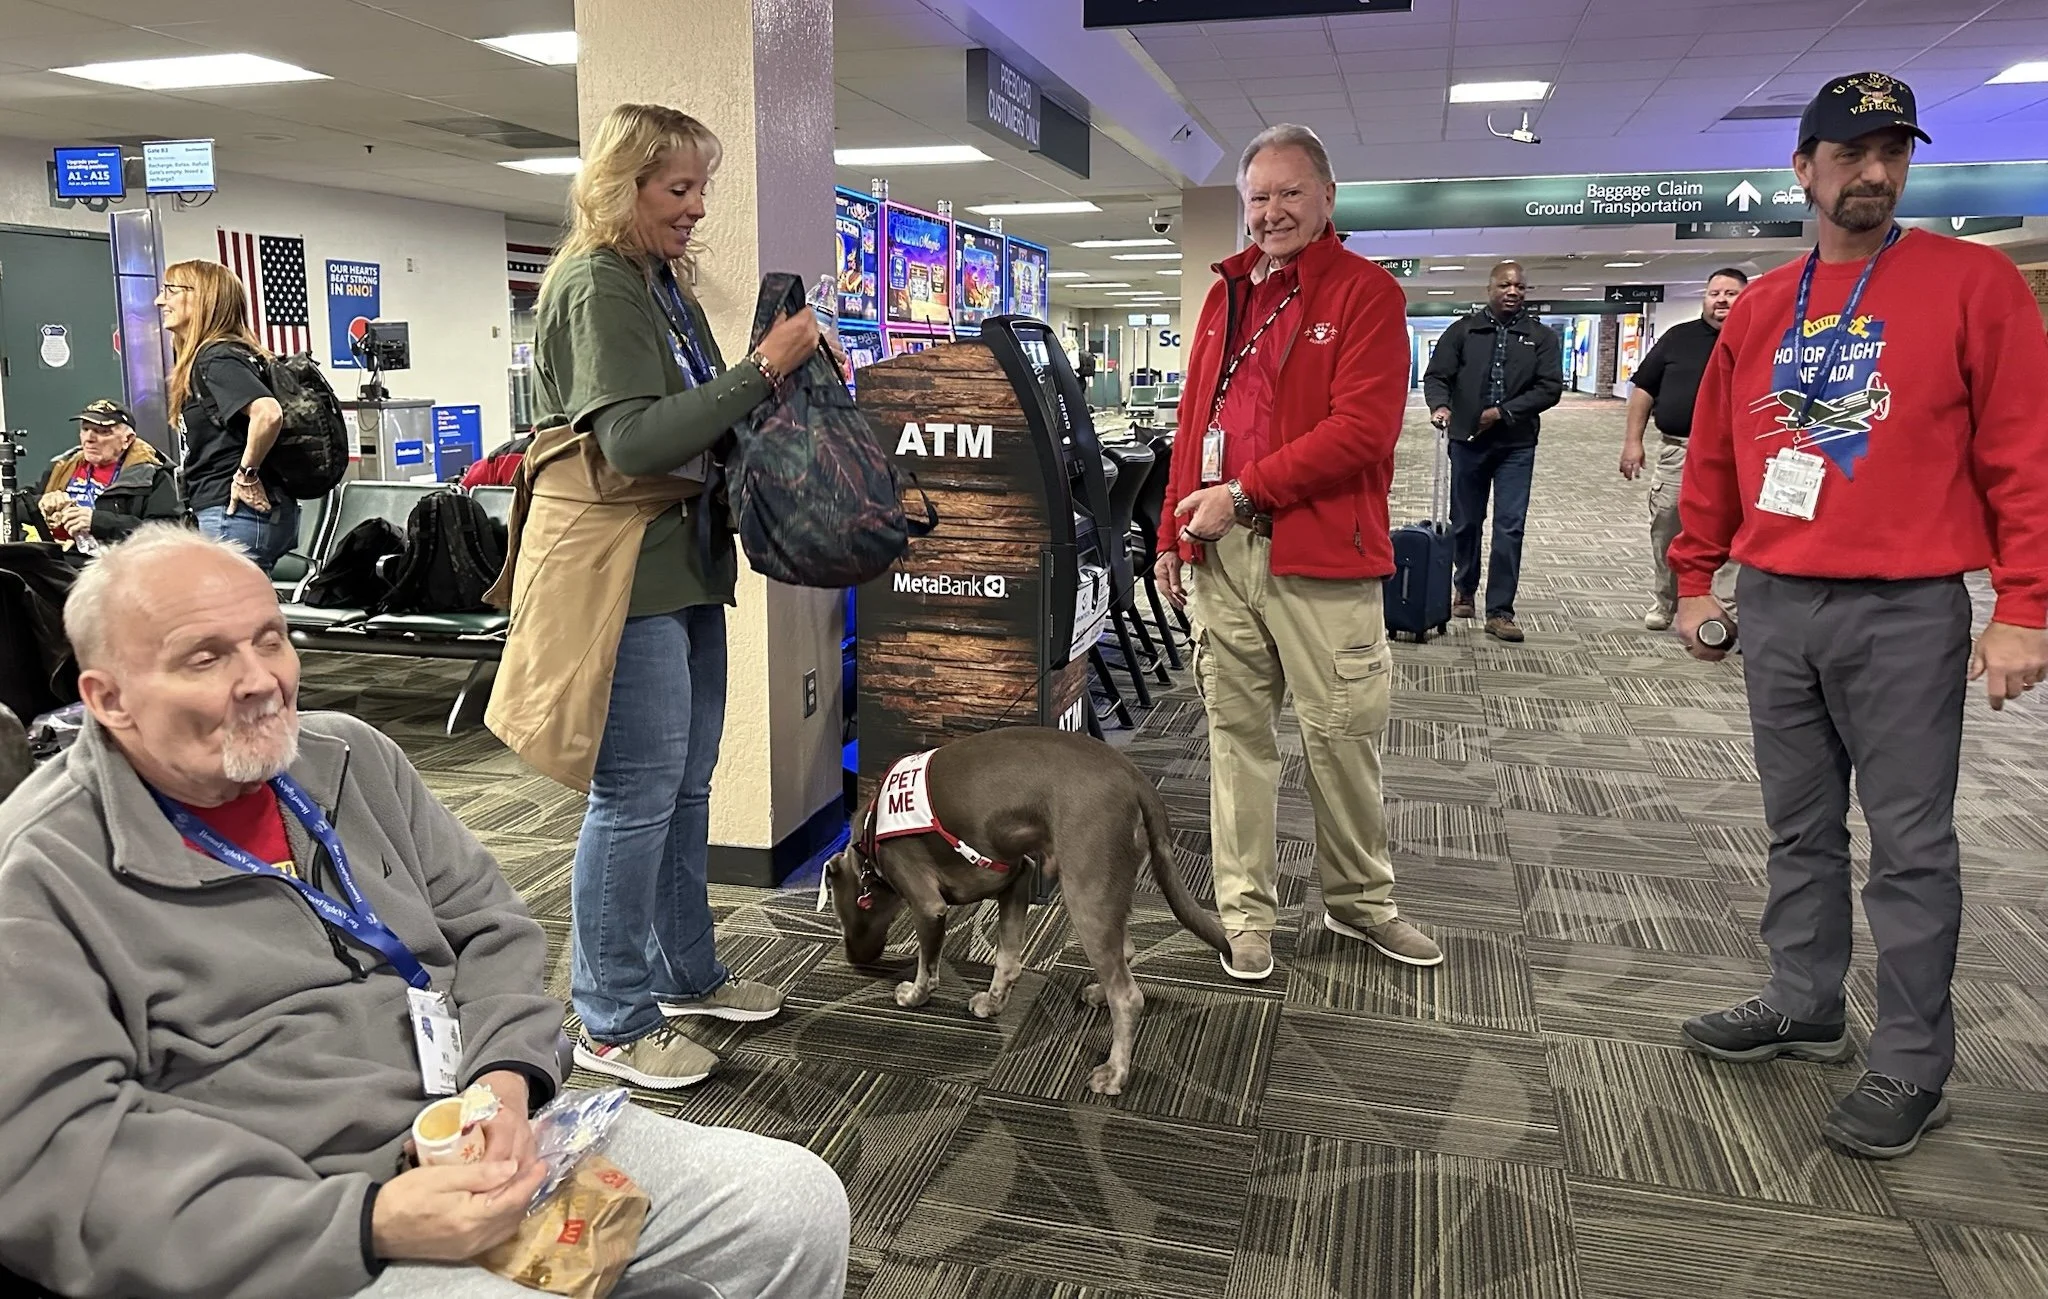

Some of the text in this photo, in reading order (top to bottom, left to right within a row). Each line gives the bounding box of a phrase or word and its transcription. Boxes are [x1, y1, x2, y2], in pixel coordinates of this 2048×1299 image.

[1000, 63, 1032, 110] PREBOARD
[988, 88, 1040, 145] CUSTOMERS ONLY
[1850, 101, 1904, 115] VETERAN
[68, 172, 82, 181] A1
[90, 171, 110, 181] A15
[1587, 181, 1703, 201] Baggage Claim
[1525, 198, 1702, 217] Ground Transportation
[330, 264, 378, 276] OUR HEARTS
[1402, 260, 1412, 268] B1
[330, 274, 378, 285] BEAT STRONG
[330, 283, 373, 297] IN RNO!
[1773, 346, 1826, 365] HOOR
[1839, 341, 1887, 362] LIGHT
[1800, 364, 1855, 383] NEADA
[895, 422, 993, 458] ATM
[893, 572, 983, 597] MetaBank
[1059, 697, 1082, 732] ATM
[887, 768, 922, 792] PET
[889, 791, 914, 814] ME
